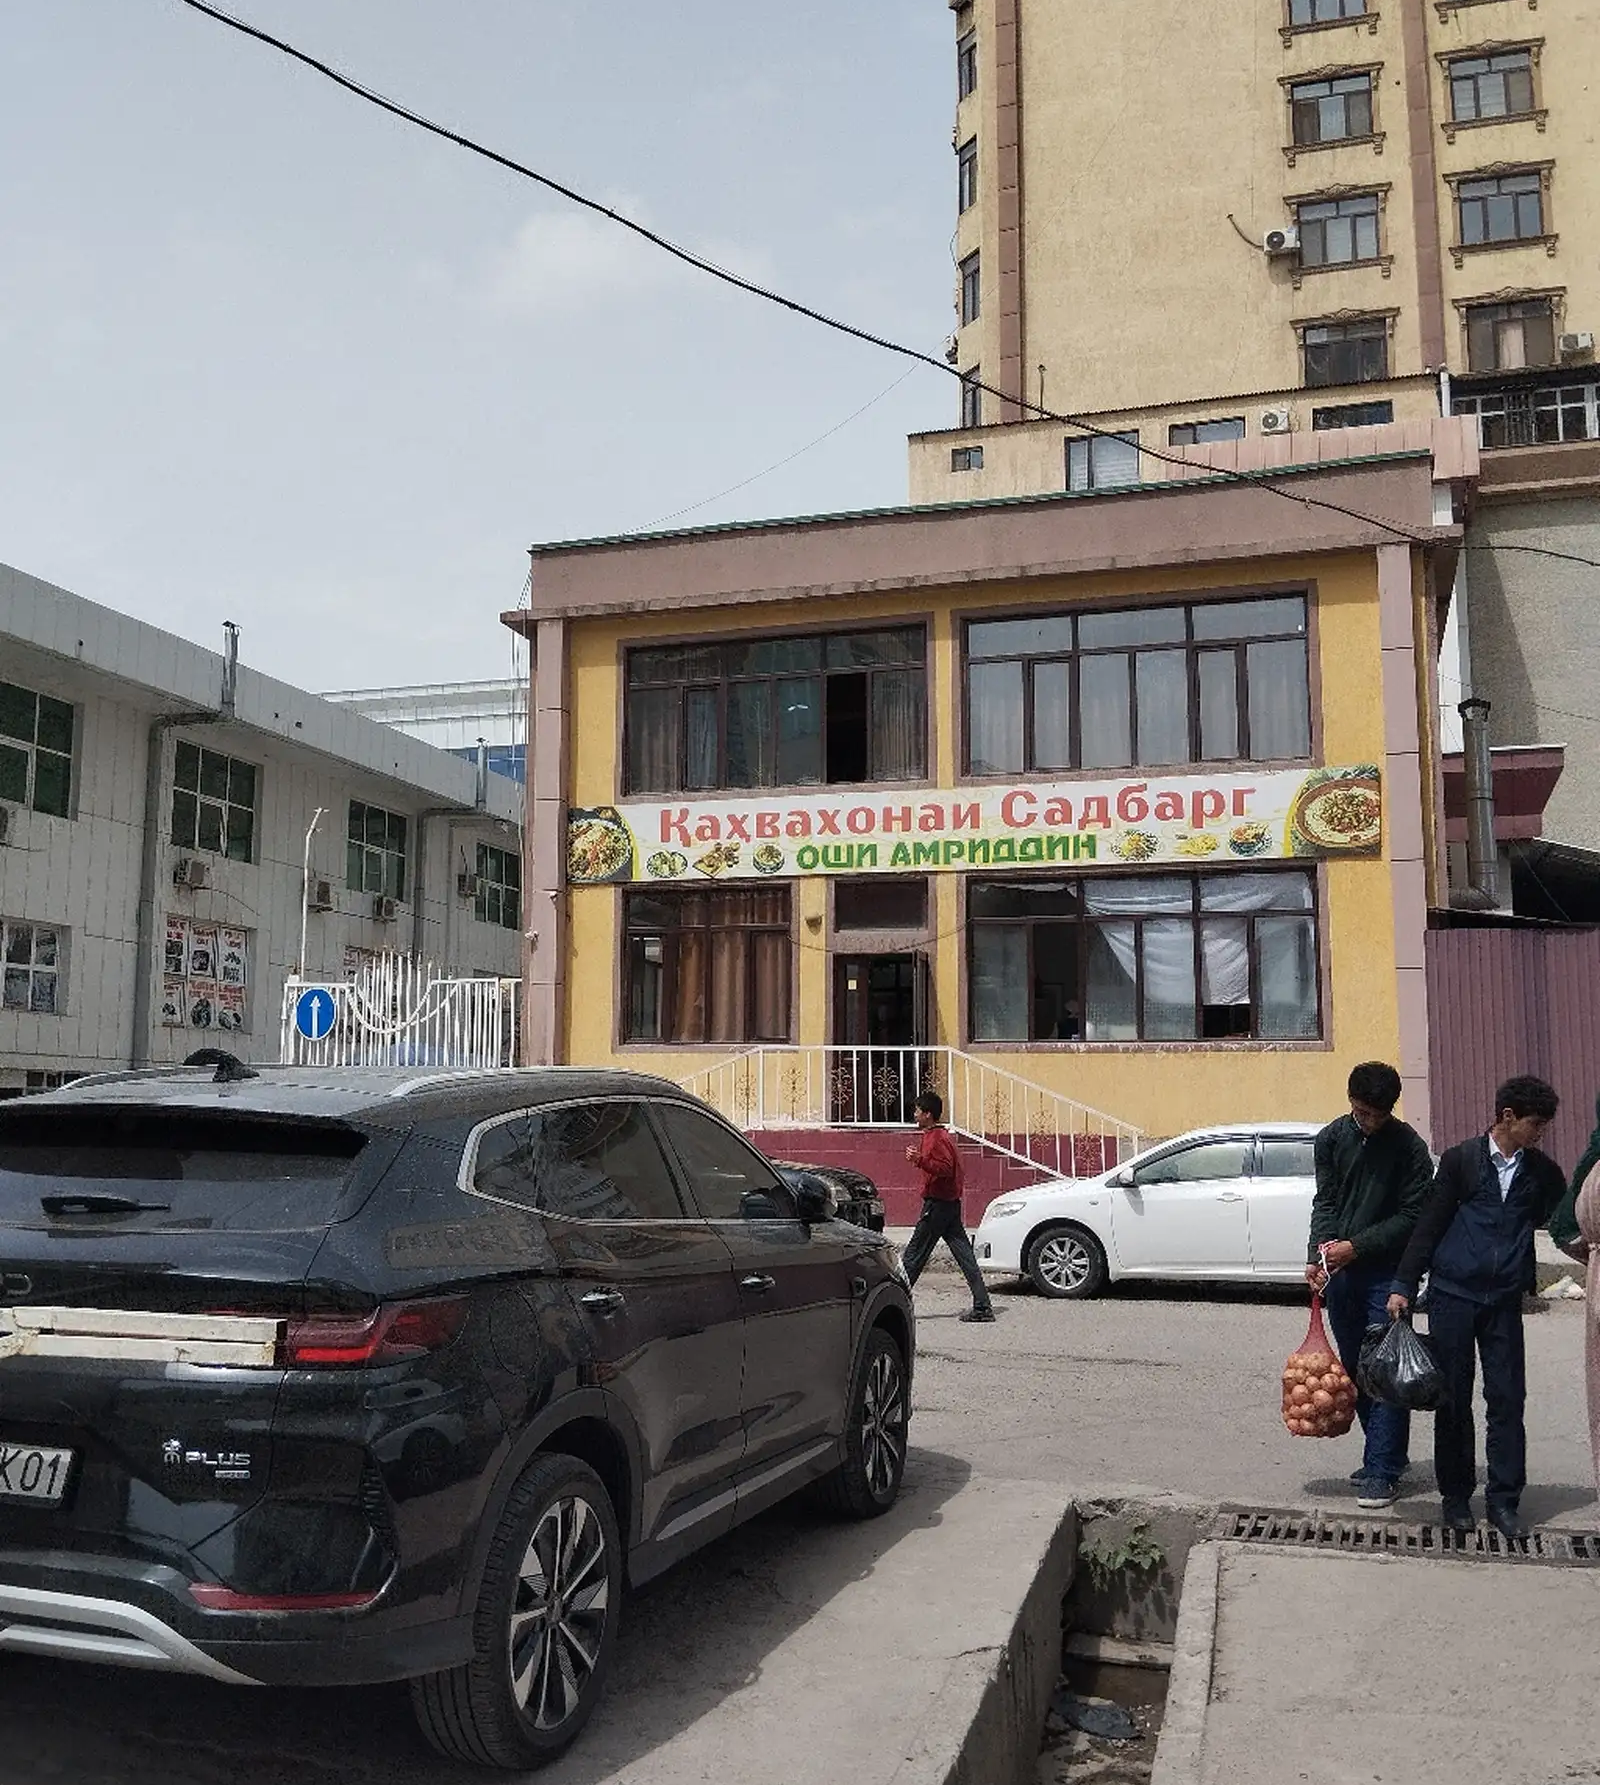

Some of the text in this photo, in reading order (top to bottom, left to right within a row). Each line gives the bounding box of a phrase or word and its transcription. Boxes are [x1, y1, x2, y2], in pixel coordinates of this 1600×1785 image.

[660, 783, 1257, 848] Қаҳвахонаи Садбарг
[796, 833, 1097, 869] ОШИ АМРИДДИН
[185, 1450, 251, 1465] PLUS
